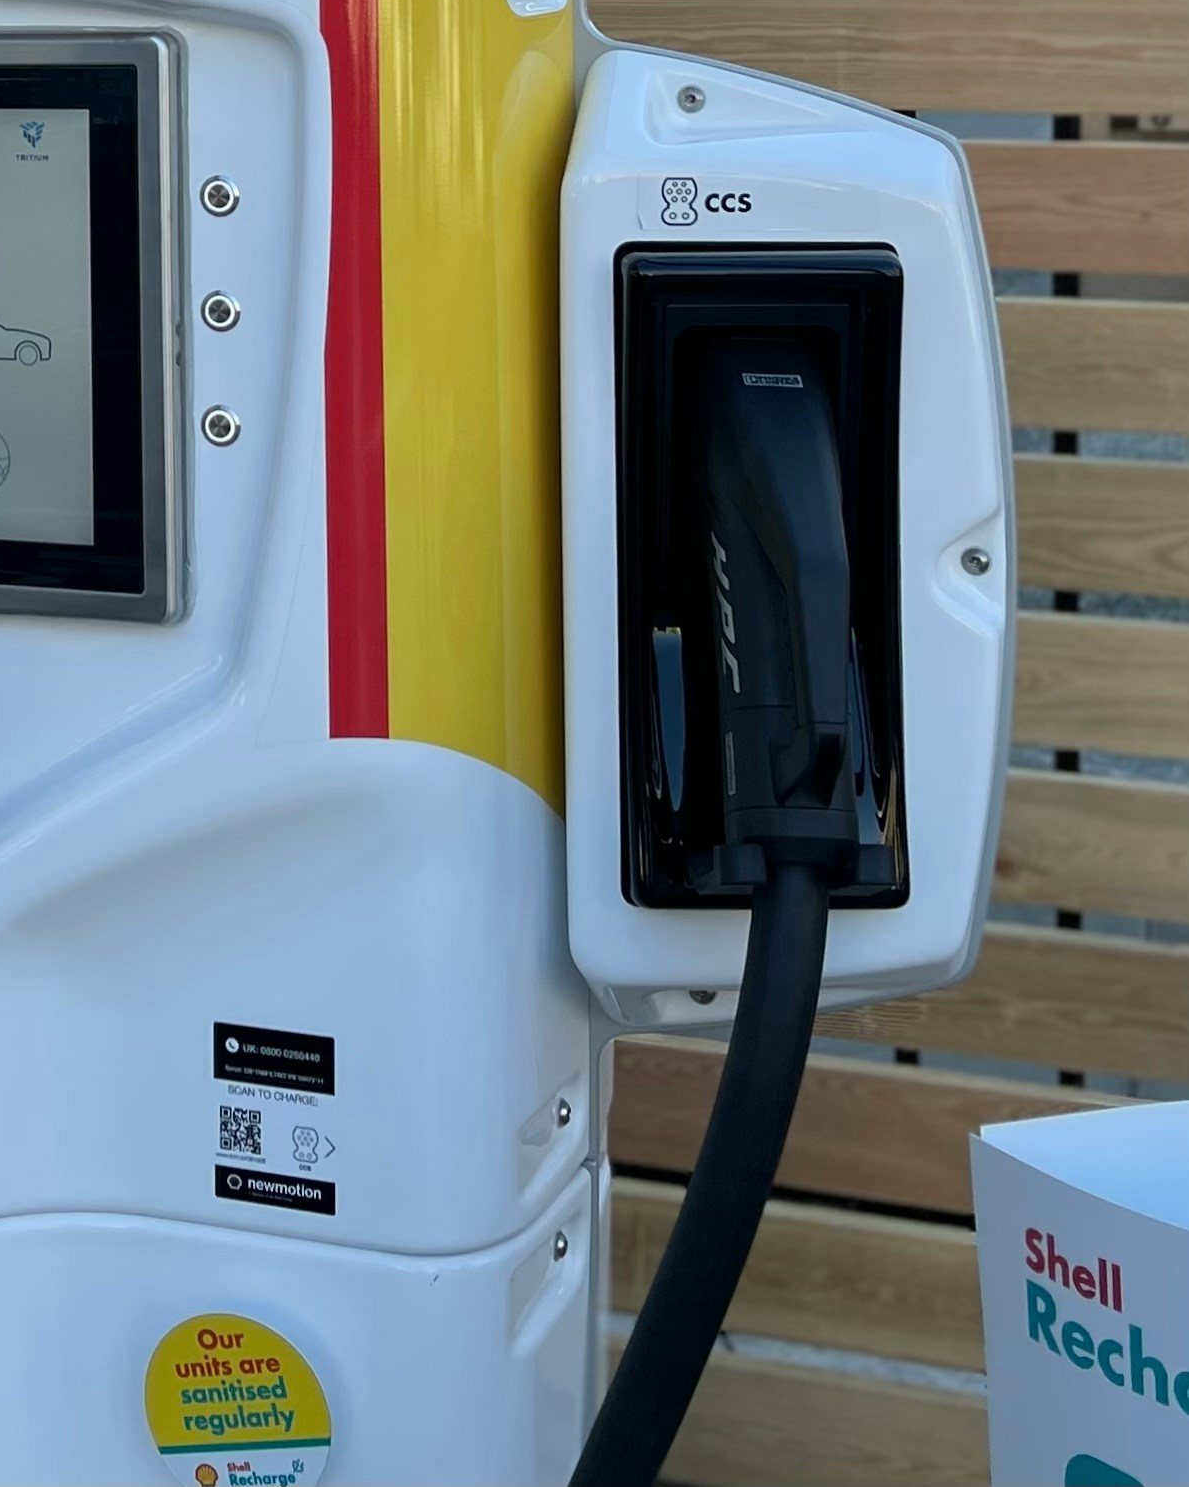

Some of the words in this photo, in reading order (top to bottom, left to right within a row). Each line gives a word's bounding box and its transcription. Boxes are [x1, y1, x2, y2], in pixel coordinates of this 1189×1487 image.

[705, 192, 752, 213] CCS
[243, 1043, 258, 1054] UK:
[260, 1046, 281, 1057] 0800
[228, 1085, 255, 1097] SCAN
[259, 1089, 271, 1099] TO
[248, 1179, 321, 1200] newmotion
[1025, 1227, 1123, 1313] Shell
[197, 1329, 244, 1350] Our
[175, 1355, 232, 1378] units
[239, 1357, 280, 1374] are
[181, 1376, 287, 1404] sanitised
[184, 1403, 295, 1435] regularly
[227, 1462, 251, 1472] Shell
[229, 1471, 295, 1487] Recharge
